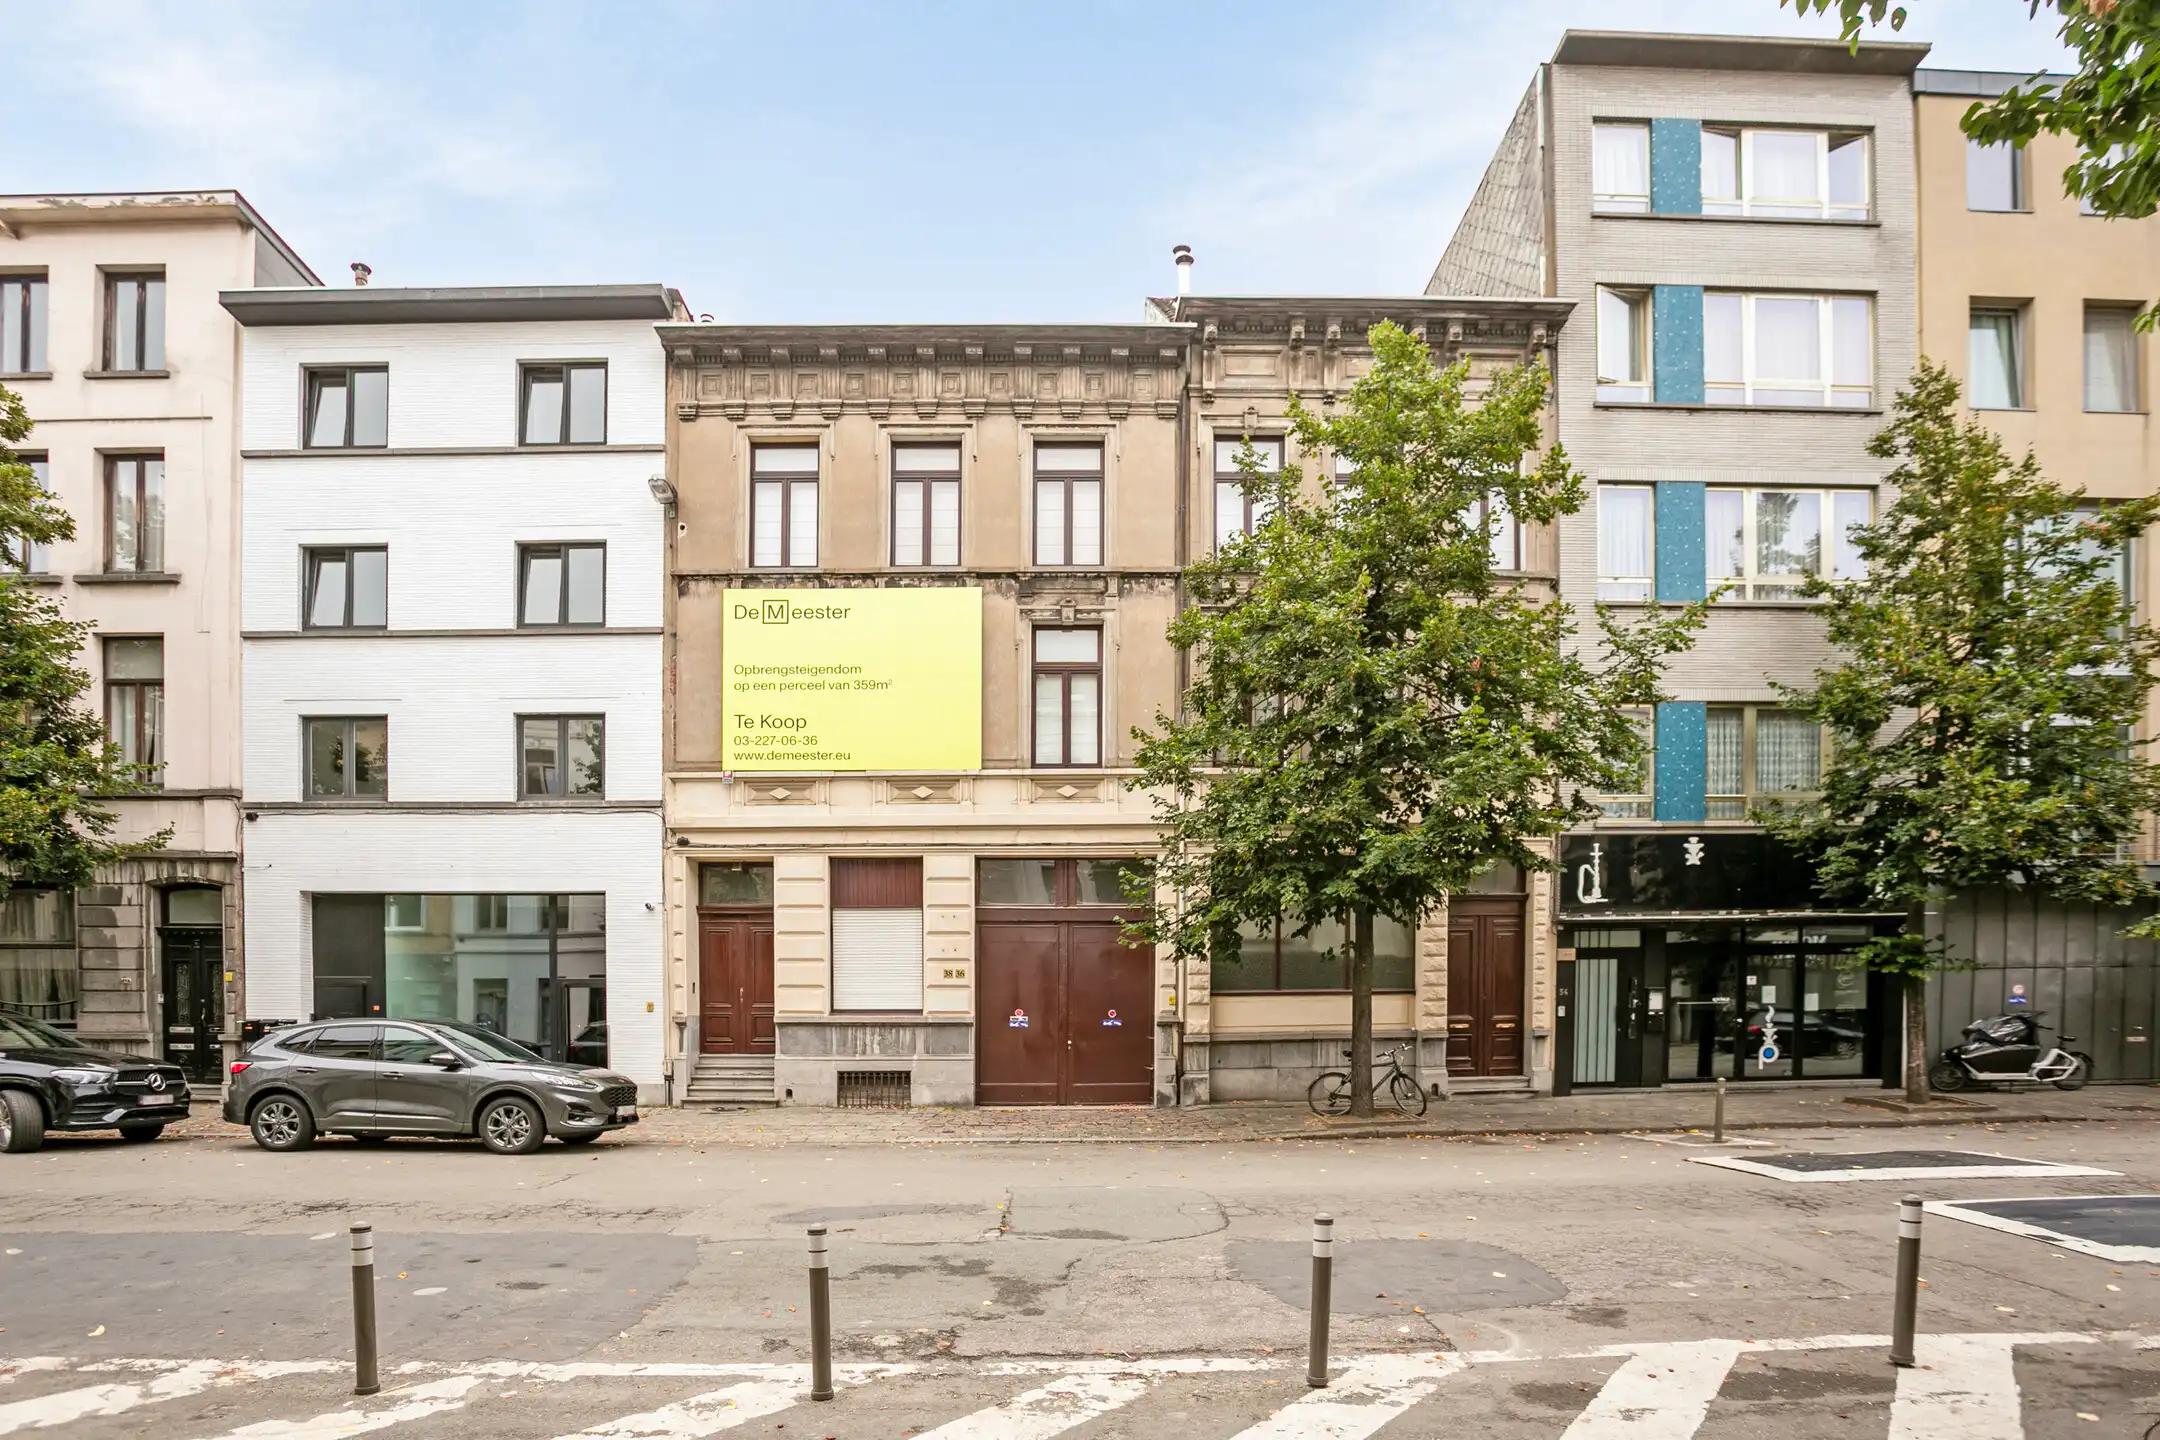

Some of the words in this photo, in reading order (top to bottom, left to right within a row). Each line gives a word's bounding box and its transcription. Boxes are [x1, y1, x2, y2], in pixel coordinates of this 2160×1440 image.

[733, 664, 862, 677] Opbrengsteigendom
[733, 682, 750, 693] op
[753, 682, 776, 691] een
[779, 680, 826, 693] perceel
[828, 681, 850, 691] van
[733, 714, 755, 729] Te
[760, 714, 807, 732] Koop
[733, 735, 819, 746] 03-227-06-36
[733, 750, 851, 761] www.demeester.eu
[944, 969, 954, 979] 38
[955, 969, 965, 979] 36
